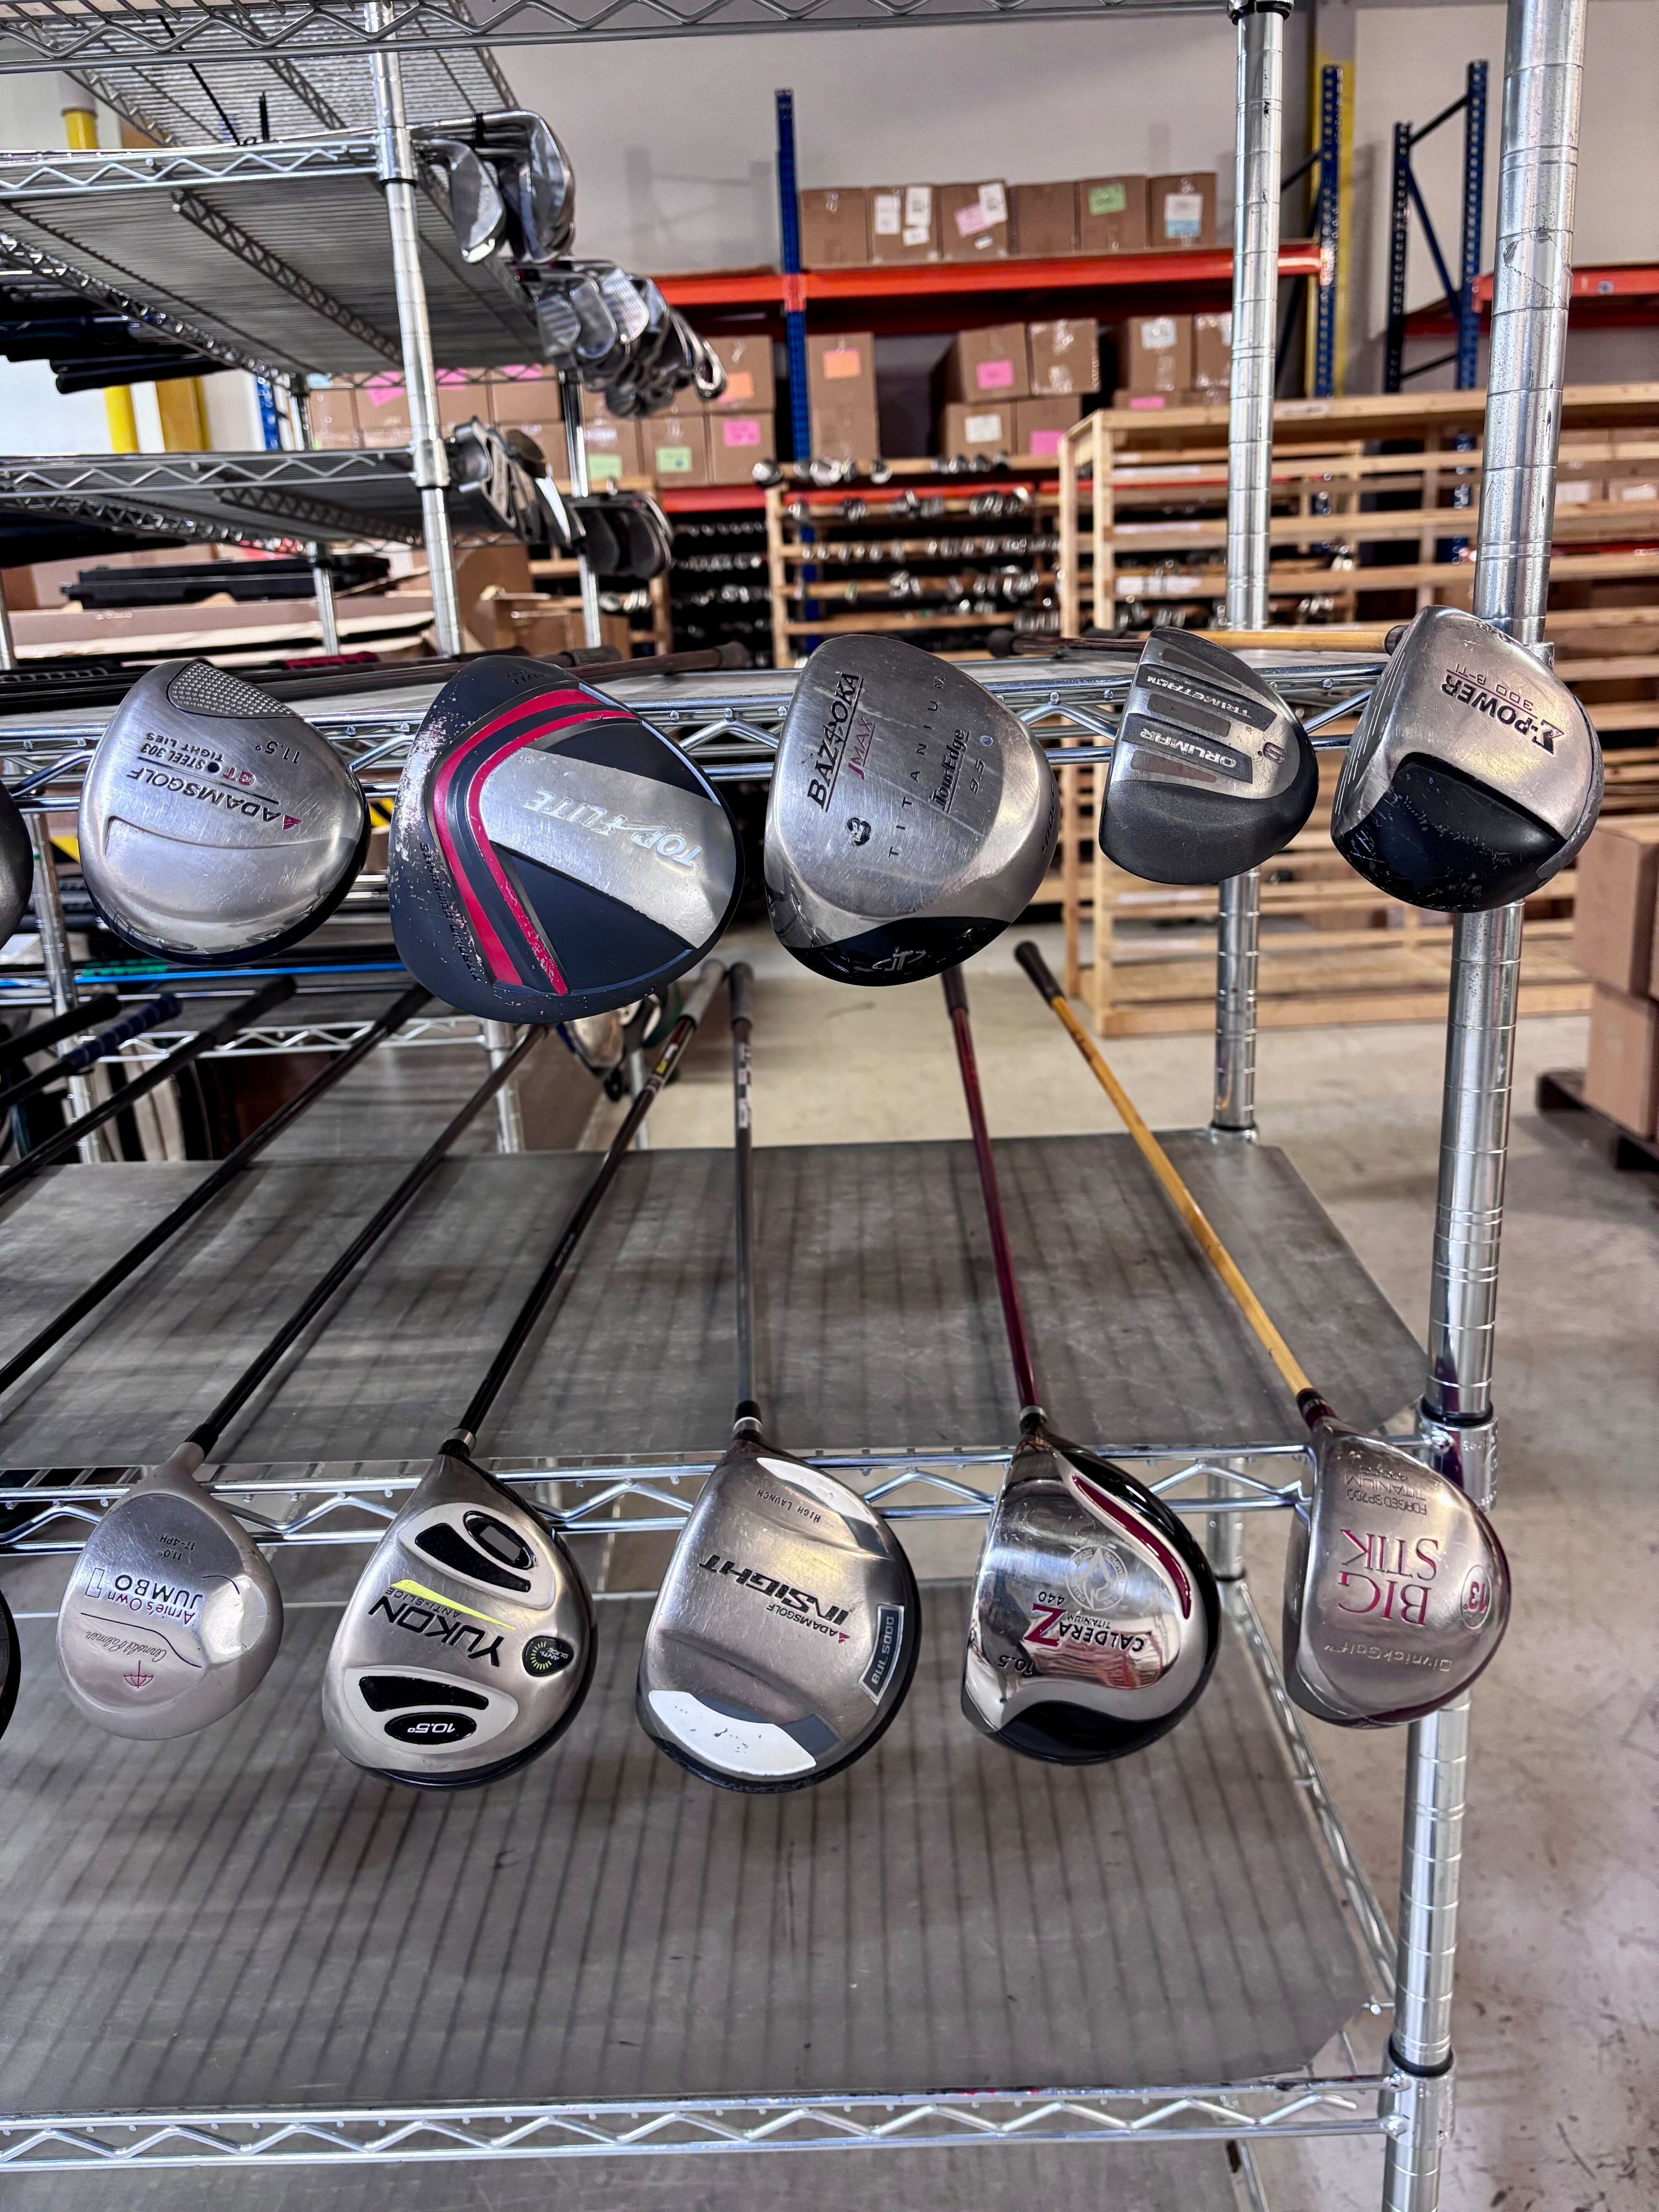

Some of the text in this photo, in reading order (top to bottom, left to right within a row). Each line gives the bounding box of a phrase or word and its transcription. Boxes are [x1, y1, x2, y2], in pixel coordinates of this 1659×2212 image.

[1495, 684, 1535, 712] 300
[140, 743, 257, 786] GT STEEL 303
[146, 732, 224, 761] TIGHT LIES
[848, 717, 876, 780] JMAX
[1140, 728, 1237, 769] ORLIMAR
[127, 766, 283, 823] ADAMSGOLF
[631, 831, 702, 868] TOP
[450, 924, 481, 982] TITANIUM
[1344, 1474, 1427, 1501] TITANIUM
[756, 1489, 822, 1523] HIGH LAUNCH
[1340, 1529, 1439, 1581] STIK
[107, 1590, 195, 1626] Arnie's Own
[114, 1574, 204, 1610] JUMBO
[385, 1586, 462, 1618] ANTI-SLICE
[699, 1554, 851, 1626] INSIGHT
[1038, 1590, 1065, 1604] 440
[1338, 1571, 1432, 1625] BIG
[368, 1596, 505, 1667] YUKON
[766, 1604, 838, 1637] ADAMSGOLF
[1058, 1622, 1146, 1652] CALDERA
[1066, 1612, 1111, 1629] TITANIUM
[547, 1647, 569, 1658] SLICE
[871, 1616, 894, 1685] BUL 5000
[997, 1655, 1034, 1675] 10.5
